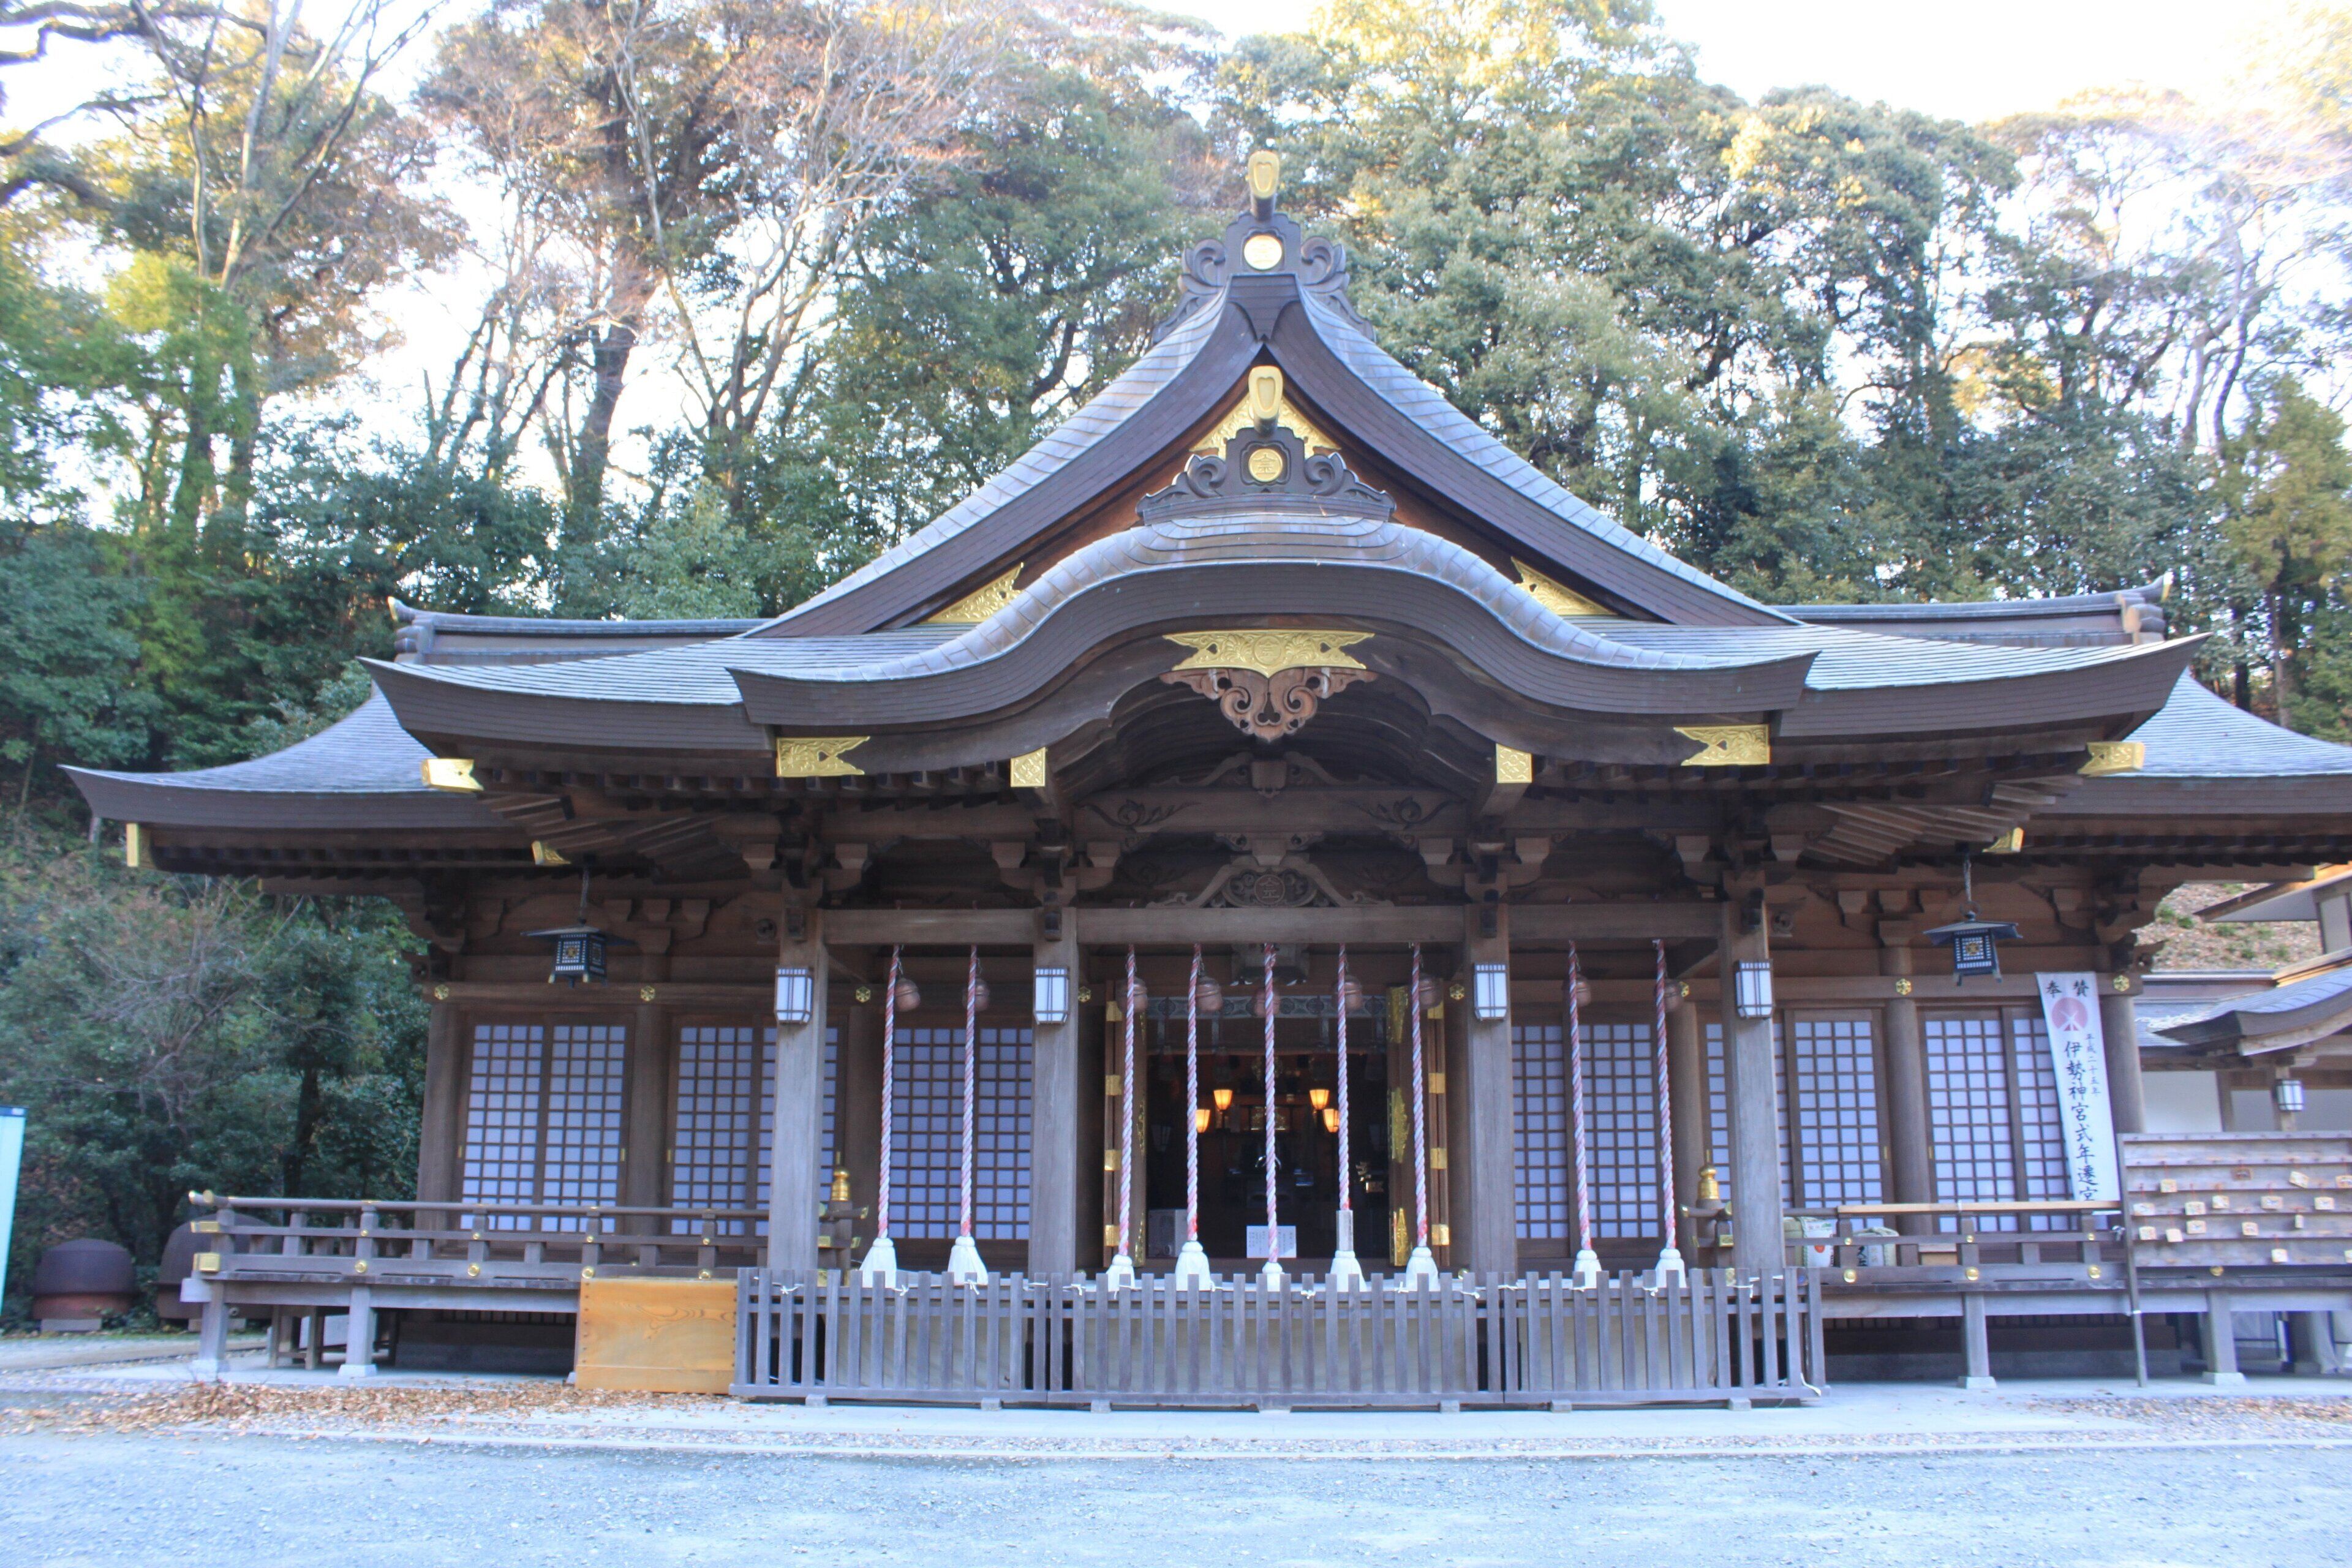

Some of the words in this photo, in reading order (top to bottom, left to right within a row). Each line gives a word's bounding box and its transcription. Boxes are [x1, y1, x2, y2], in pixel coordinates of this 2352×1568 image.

[2046, 980, 2089, 998] 奉賛
[2086, 1033, 2101, 1097] 平成二十五年
[2064, 1041, 2098, 1201] 伊勢神宮式年遷宮
